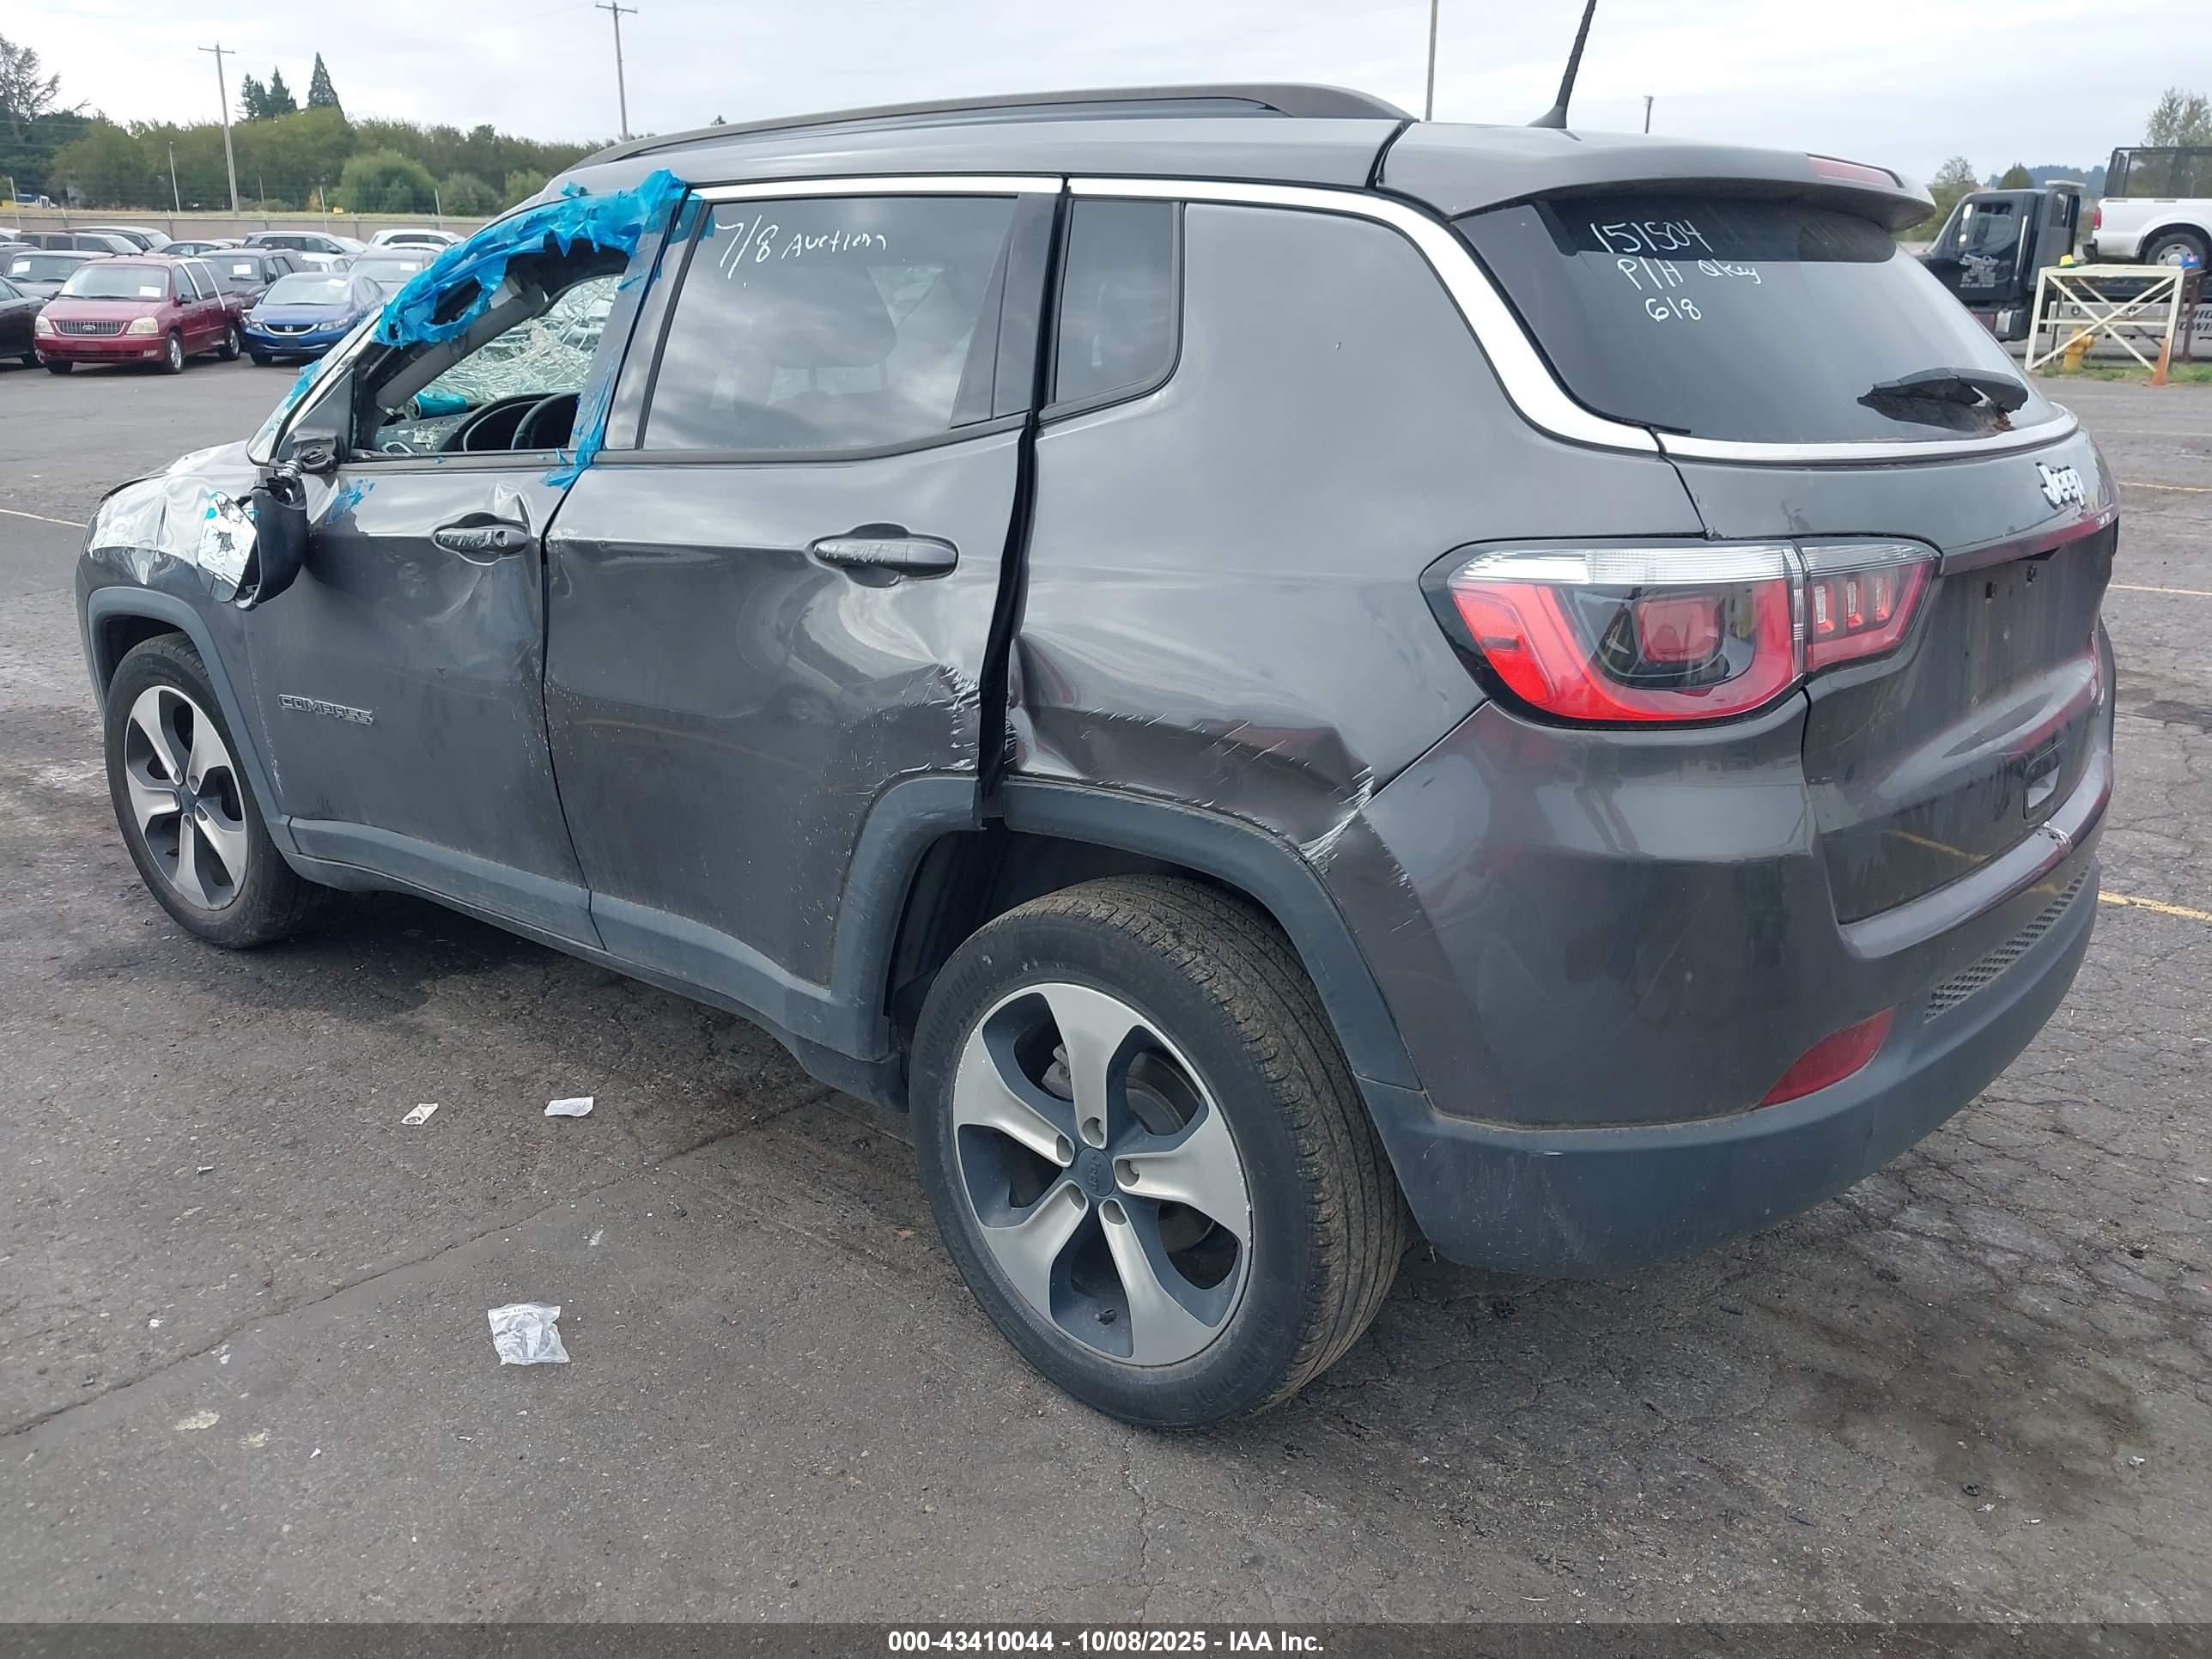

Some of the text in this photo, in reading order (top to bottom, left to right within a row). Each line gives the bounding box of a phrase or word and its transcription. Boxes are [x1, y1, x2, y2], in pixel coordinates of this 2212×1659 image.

[714, 214, 779, 280] 7/8
[1589, 219, 1714, 255] 151504
[2034, 462, 2086, 508] Jeep
[277, 694, 374, 726] COMPASS
